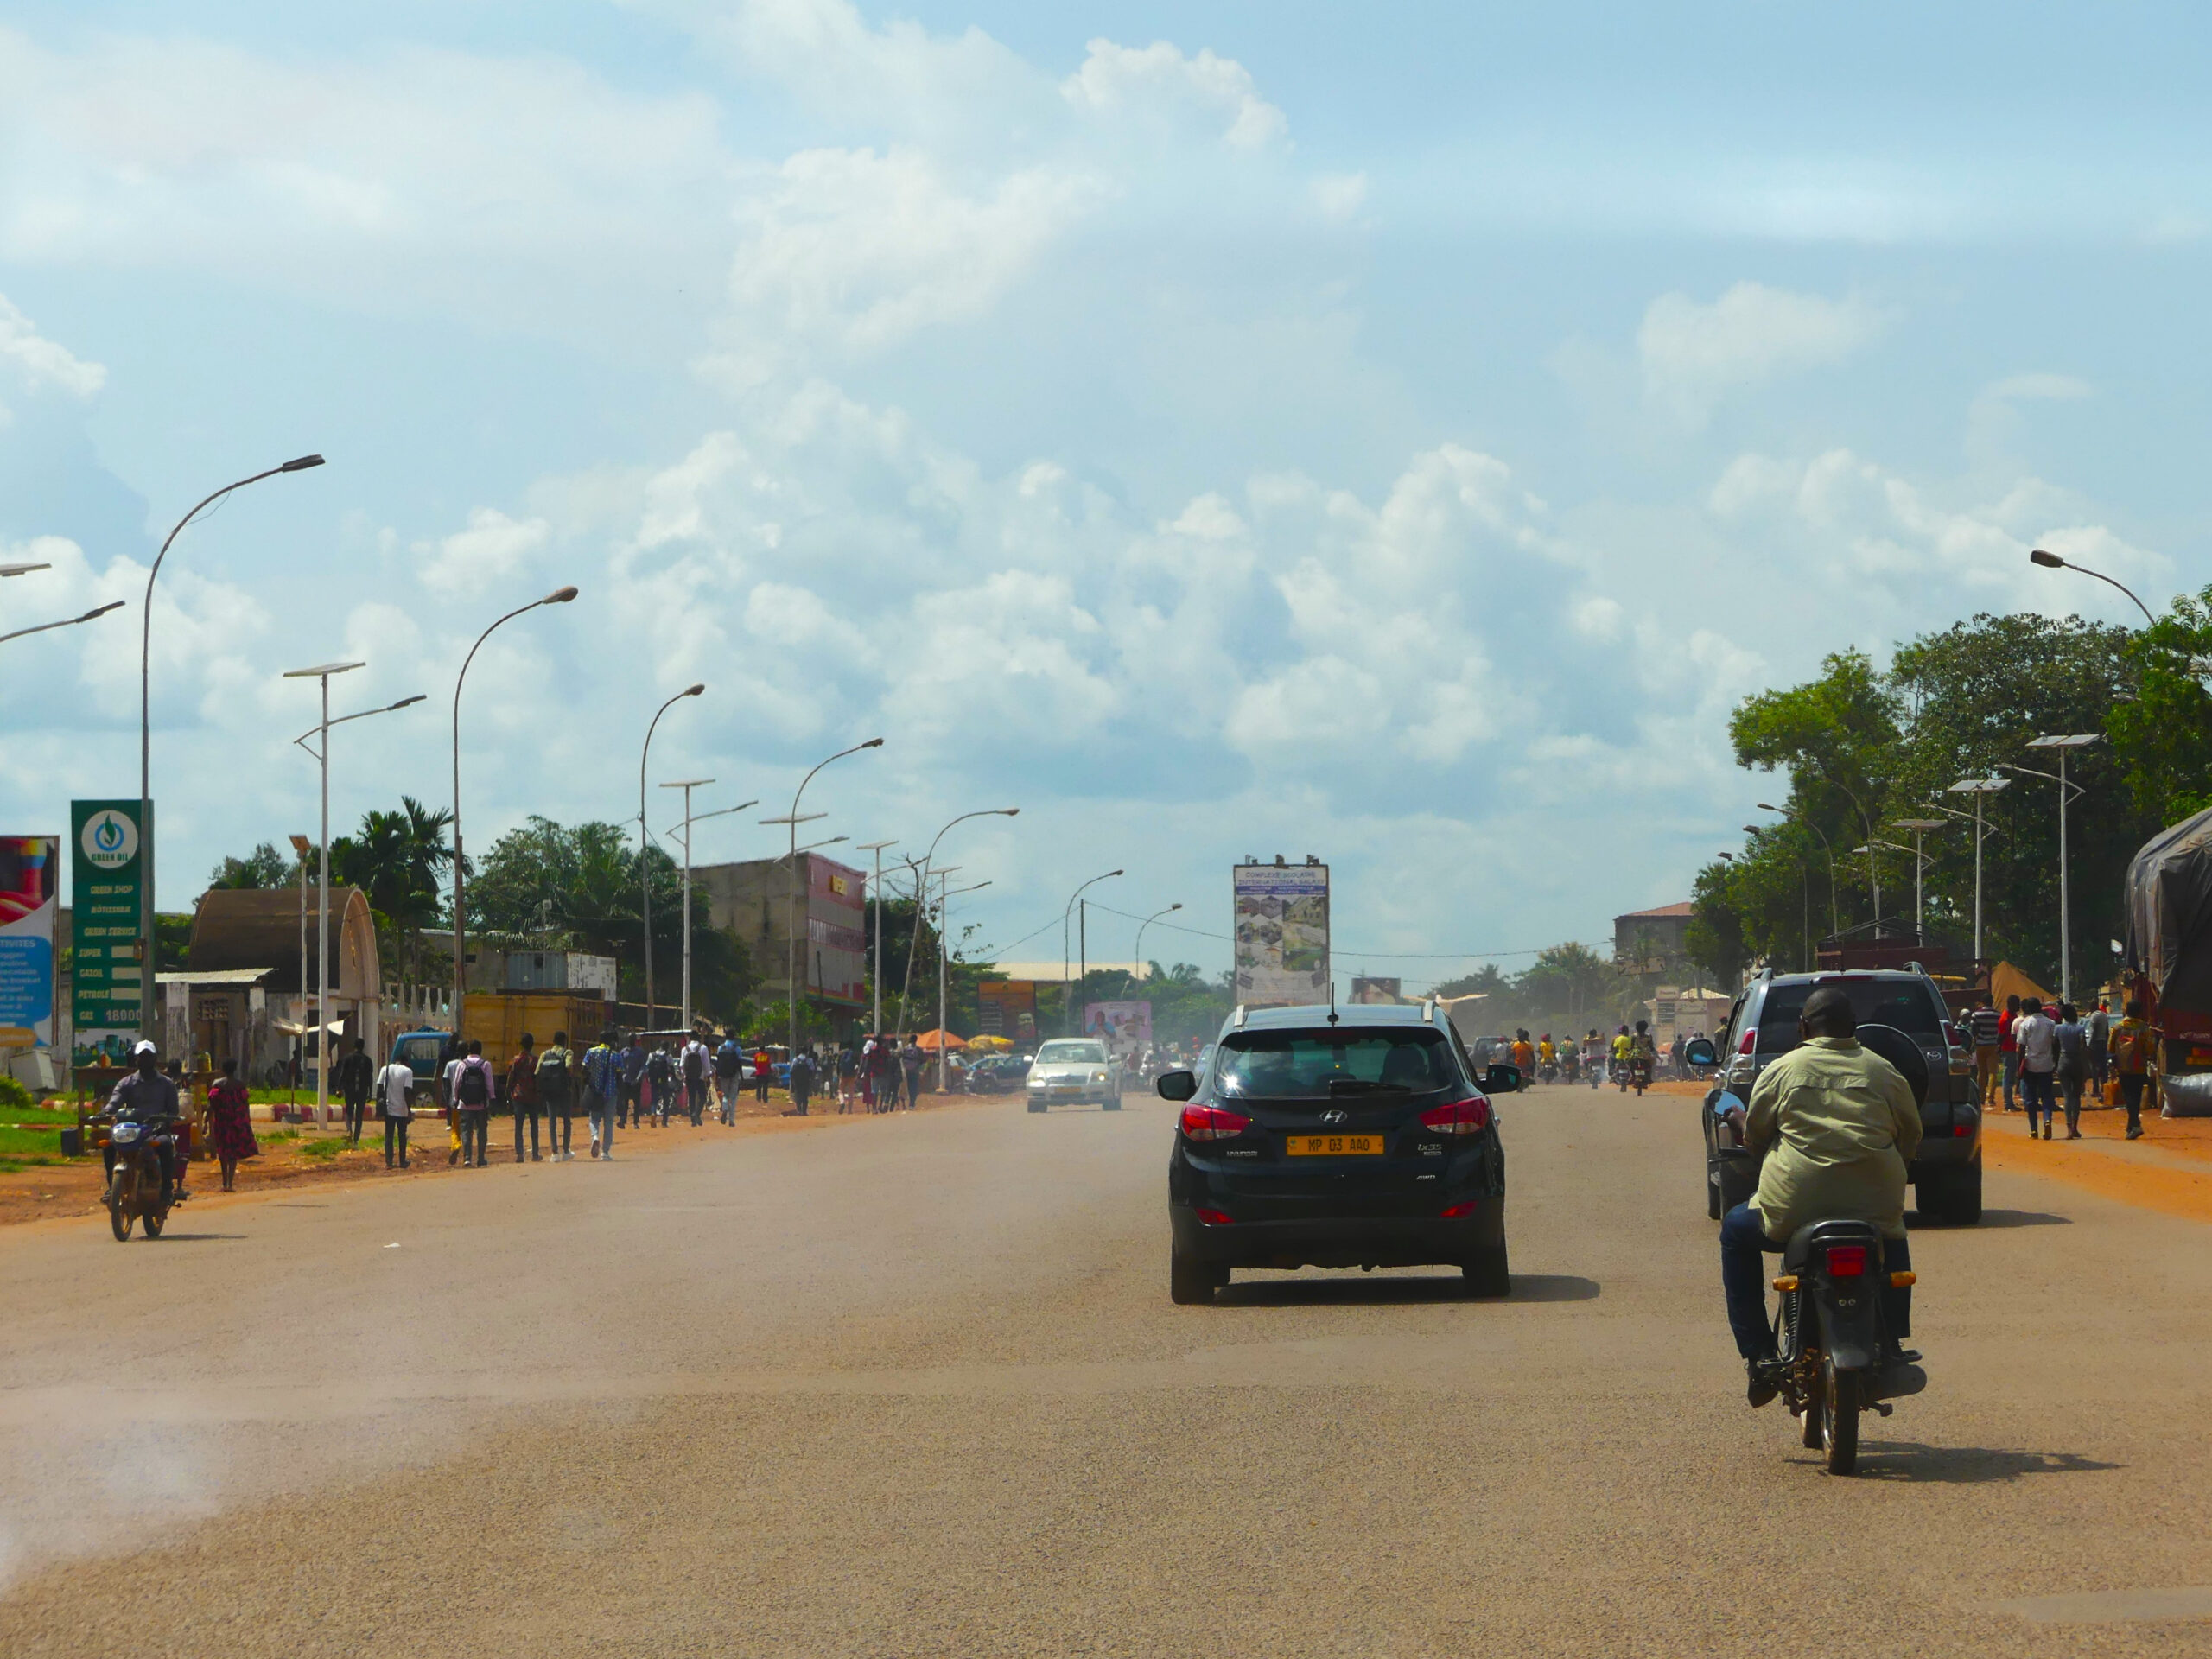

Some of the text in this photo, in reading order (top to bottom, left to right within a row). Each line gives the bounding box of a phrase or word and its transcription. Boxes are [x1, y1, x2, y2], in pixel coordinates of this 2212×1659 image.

[92, 853, 129, 861] GREEN OIL
[91, 885, 134, 894] GREEN SHOP
[84, 927, 137, 936] GREEN SERVICE
[79, 948, 102, 957] SUPER
[79, 990, 110, 999] PETROLE
[1308, 1139, 1322, 1152] MP
